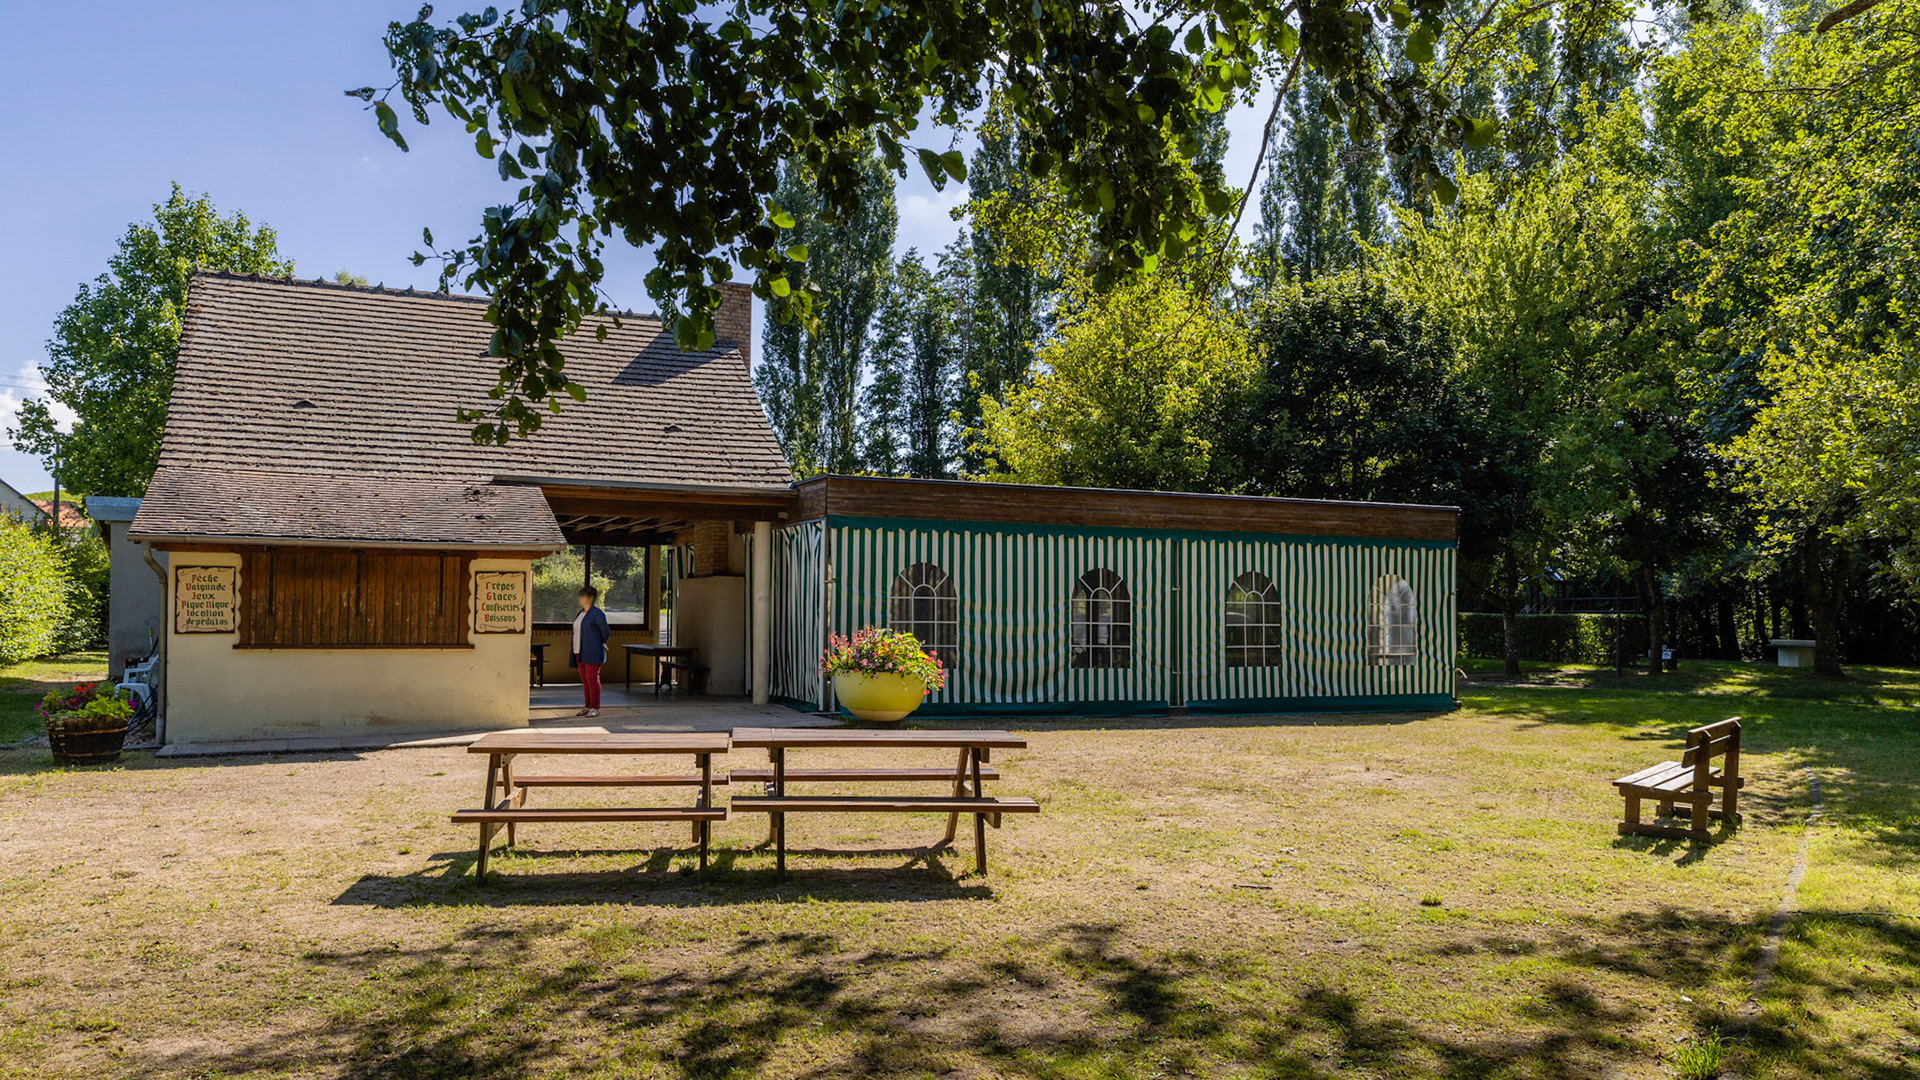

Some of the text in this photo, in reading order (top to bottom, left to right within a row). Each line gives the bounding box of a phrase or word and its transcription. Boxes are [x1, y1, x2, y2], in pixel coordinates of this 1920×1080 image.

[191, 592, 215, 600] Jeux
[486, 592, 517, 600] Glaces
[182, 600, 204, 610] Pique
